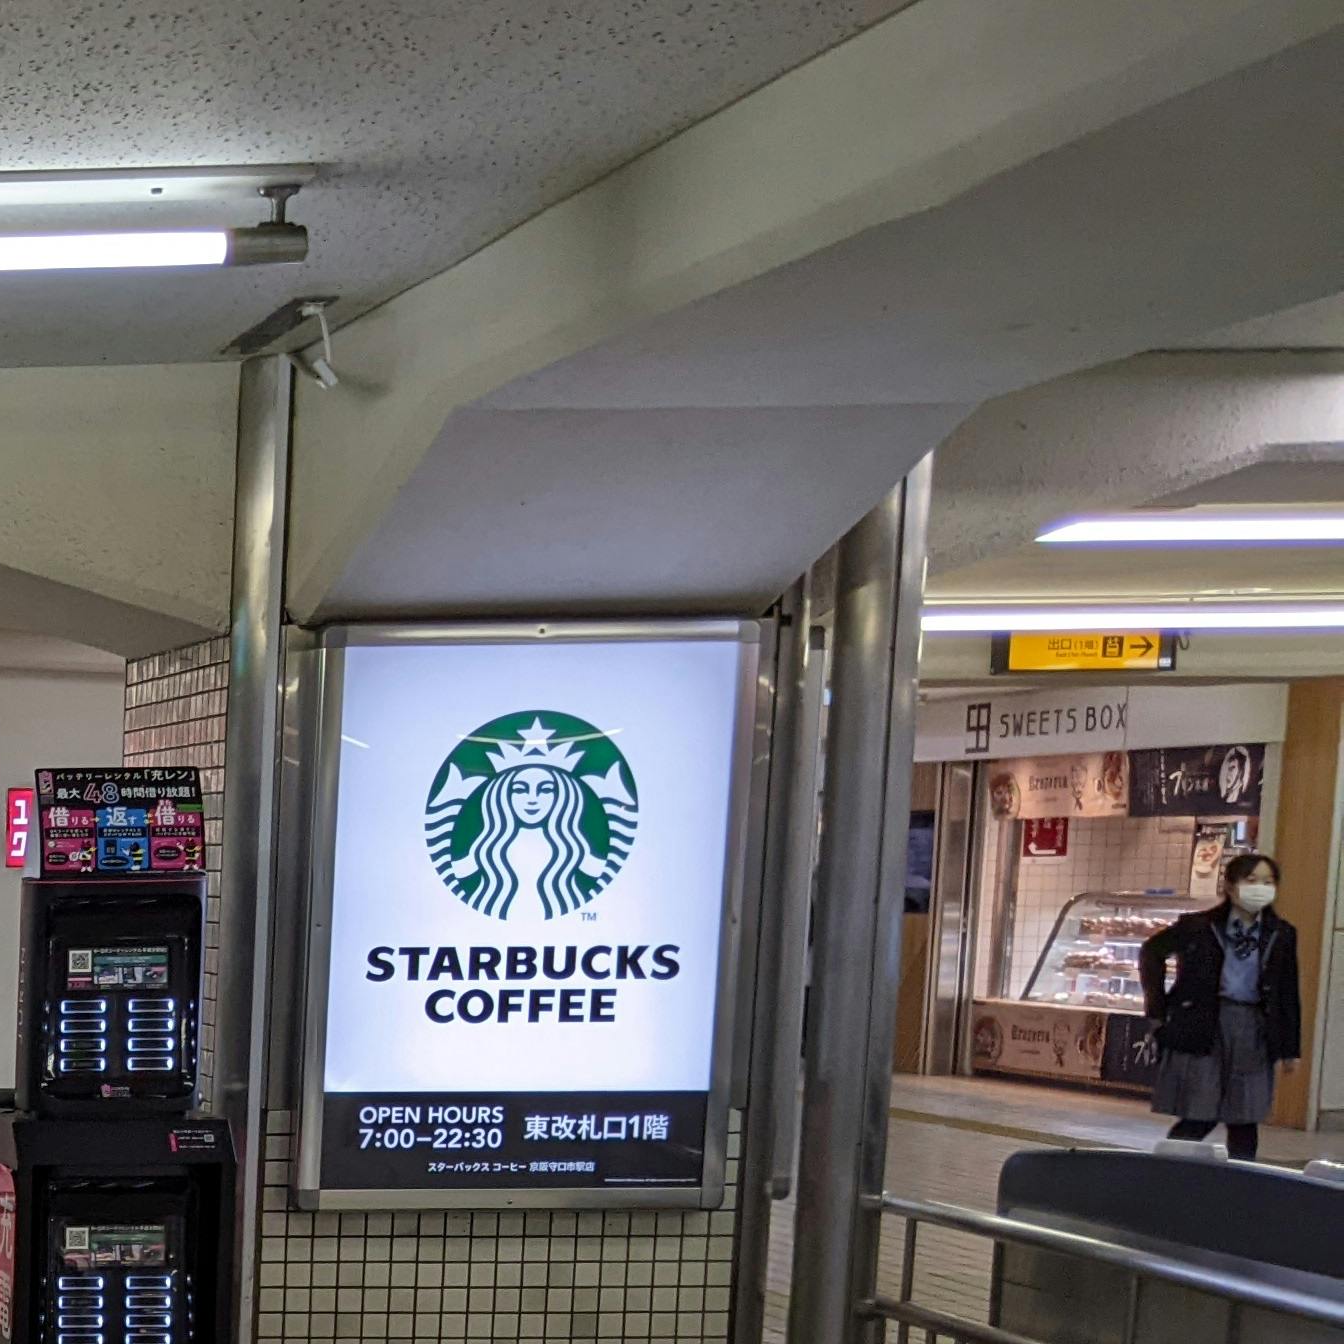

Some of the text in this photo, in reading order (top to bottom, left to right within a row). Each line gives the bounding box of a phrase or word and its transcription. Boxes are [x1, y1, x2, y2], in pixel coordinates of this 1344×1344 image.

[999, 702, 1127, 738] SWEETS BOX
[48, 806, 89, 827] 借りる
[106, 806, 136, 827] 返す
[155, 805, 196, 826] 借りる
[365, 943, 681, 983] STARBUCKS
[424, 987, 618, 1024] COFFEE
[358, 1105, 504, 1125] OPEN HOURS
[523, 1114, 670, 1141] 東改札口1階
[427, 1162, 490, 1173] スターバックス
[492, 1162, 527, 1172] コーヒー
